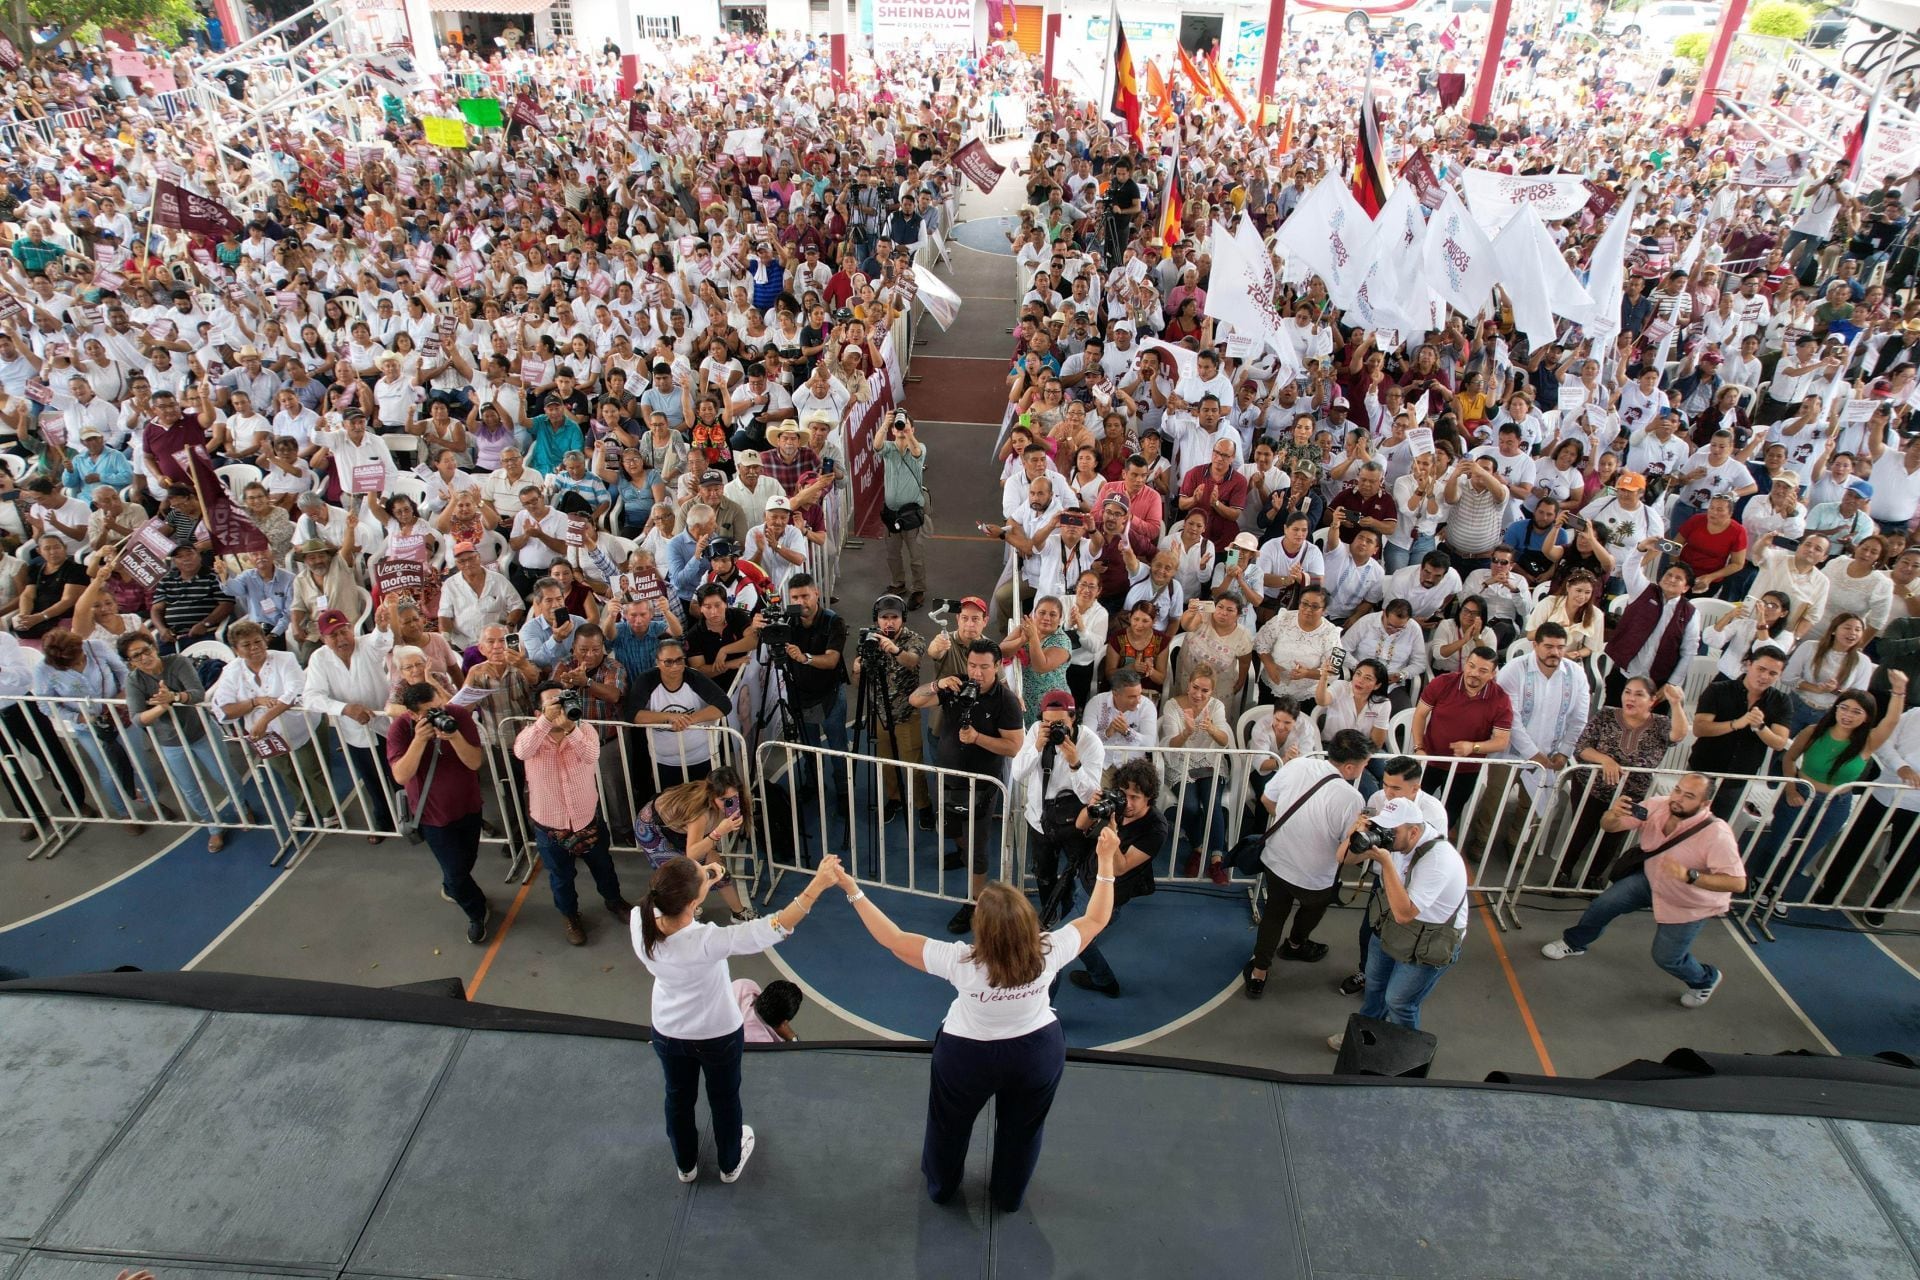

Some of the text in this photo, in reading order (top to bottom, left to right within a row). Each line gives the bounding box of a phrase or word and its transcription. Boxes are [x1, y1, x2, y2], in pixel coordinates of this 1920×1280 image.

[878, 6, 970, 19] SHEINBAUM
[970, 151, 1000, 181] CLAUDIA
[1513, 182, 1554, 196] UNIDOS
[131, 543, 168, 574] Veracruz
[122, 554, 155, 584] morena
[377, 563, 422, 577] Veracruz
[380, 575, 422, 589] morena
